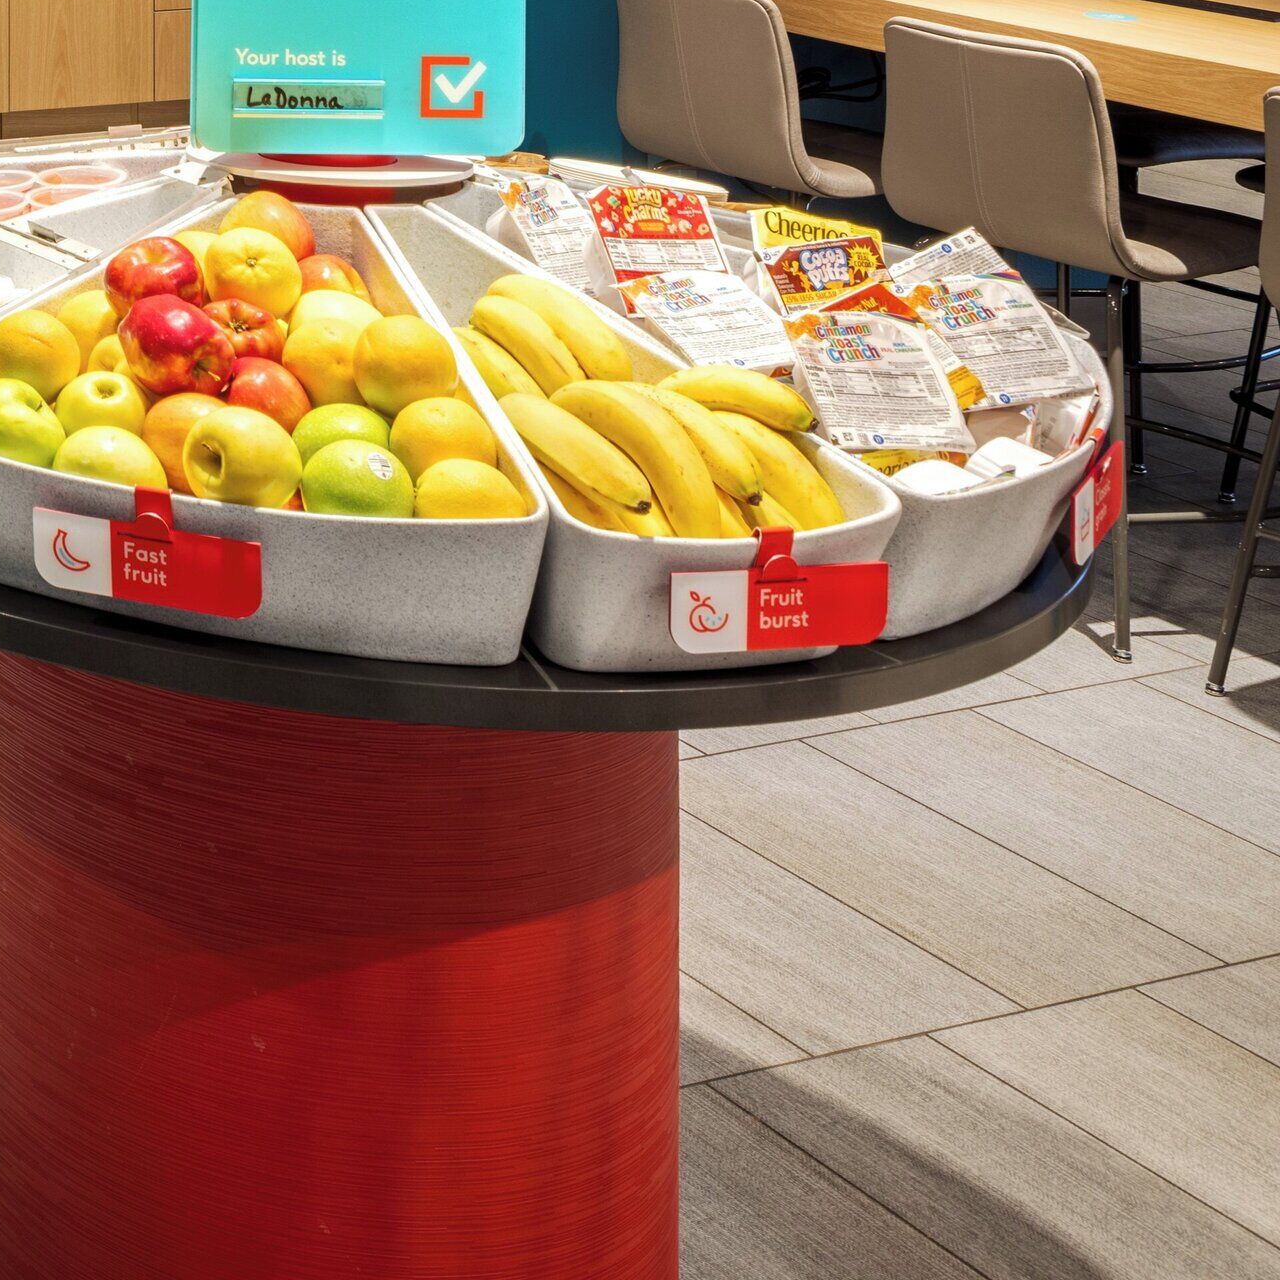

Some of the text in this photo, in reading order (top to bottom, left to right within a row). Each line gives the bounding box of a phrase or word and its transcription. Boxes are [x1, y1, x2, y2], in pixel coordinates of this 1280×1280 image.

[235, 48, 347, 66] Your host is
[519, 187, 548, 207] Cinnamon
[623, 187, 662, 207] Lucky
[530, 207, 558, 227] Crunch
[623, 204, 671, 223] Charms
[801, 249, 846, 270] Cocoa
[808, 264, 849, 290] Puffs
[649, 278, 696, 296] Cinnamon
[664, 288, 695, 302] Toast
[664, 293, 711, 314] Crunch
[929, 288, 983, 309] Cinnamon
[945, 300, 980, 315] Toast
[942, 306, 996, 330] Crunch
[817, 324, 871, 339] Cinnamon
[829, 336, 866, 349] Toast
[827, 345, 881, 363] Crunch
[123, 541, 167, 565] Fast
[123, 562, 167, 587] fruit
[760, 588, 803, 607] Fruit
[760, 611, 809, 629] burst
